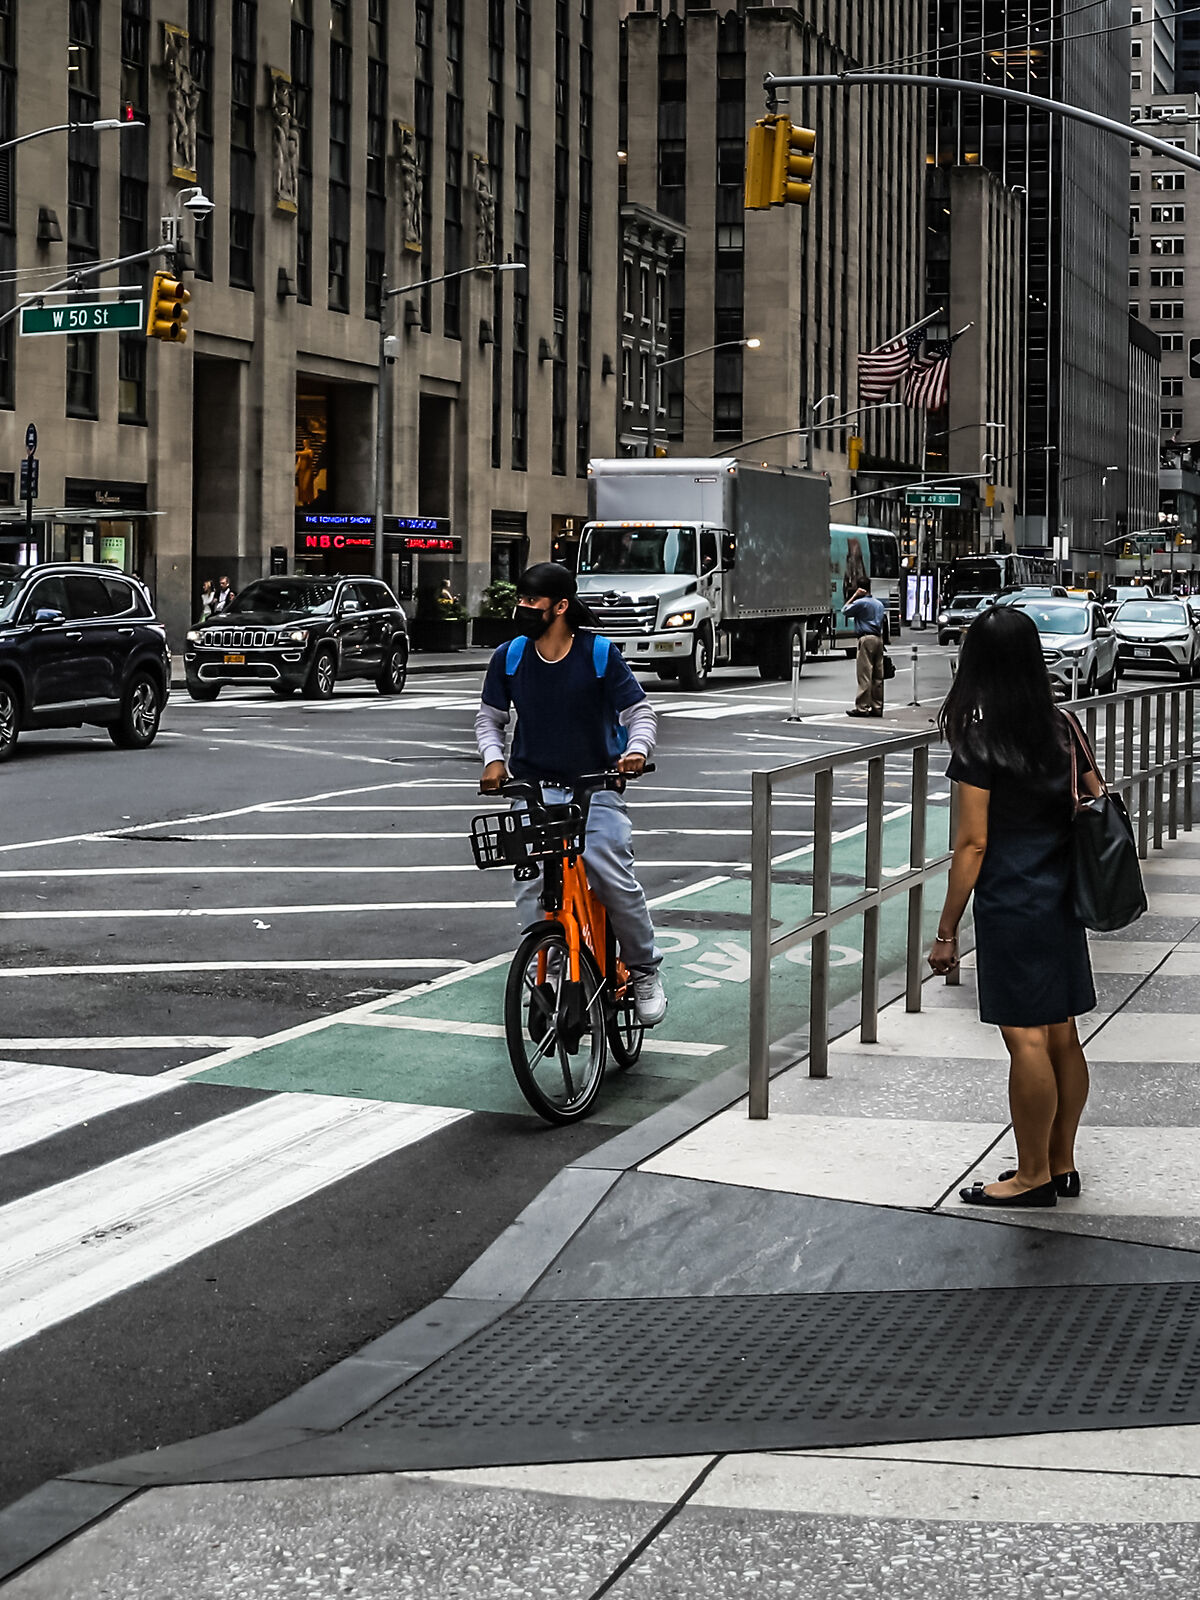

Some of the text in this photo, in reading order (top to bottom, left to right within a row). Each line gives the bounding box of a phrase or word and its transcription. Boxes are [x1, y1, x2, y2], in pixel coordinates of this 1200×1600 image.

[52, 308, 109, 328] W 50 St
[320, 516, 348, 524] TONIGHT
[350, 516, 372, 524] SHOW
[305, 535, 345, 548] NBC
